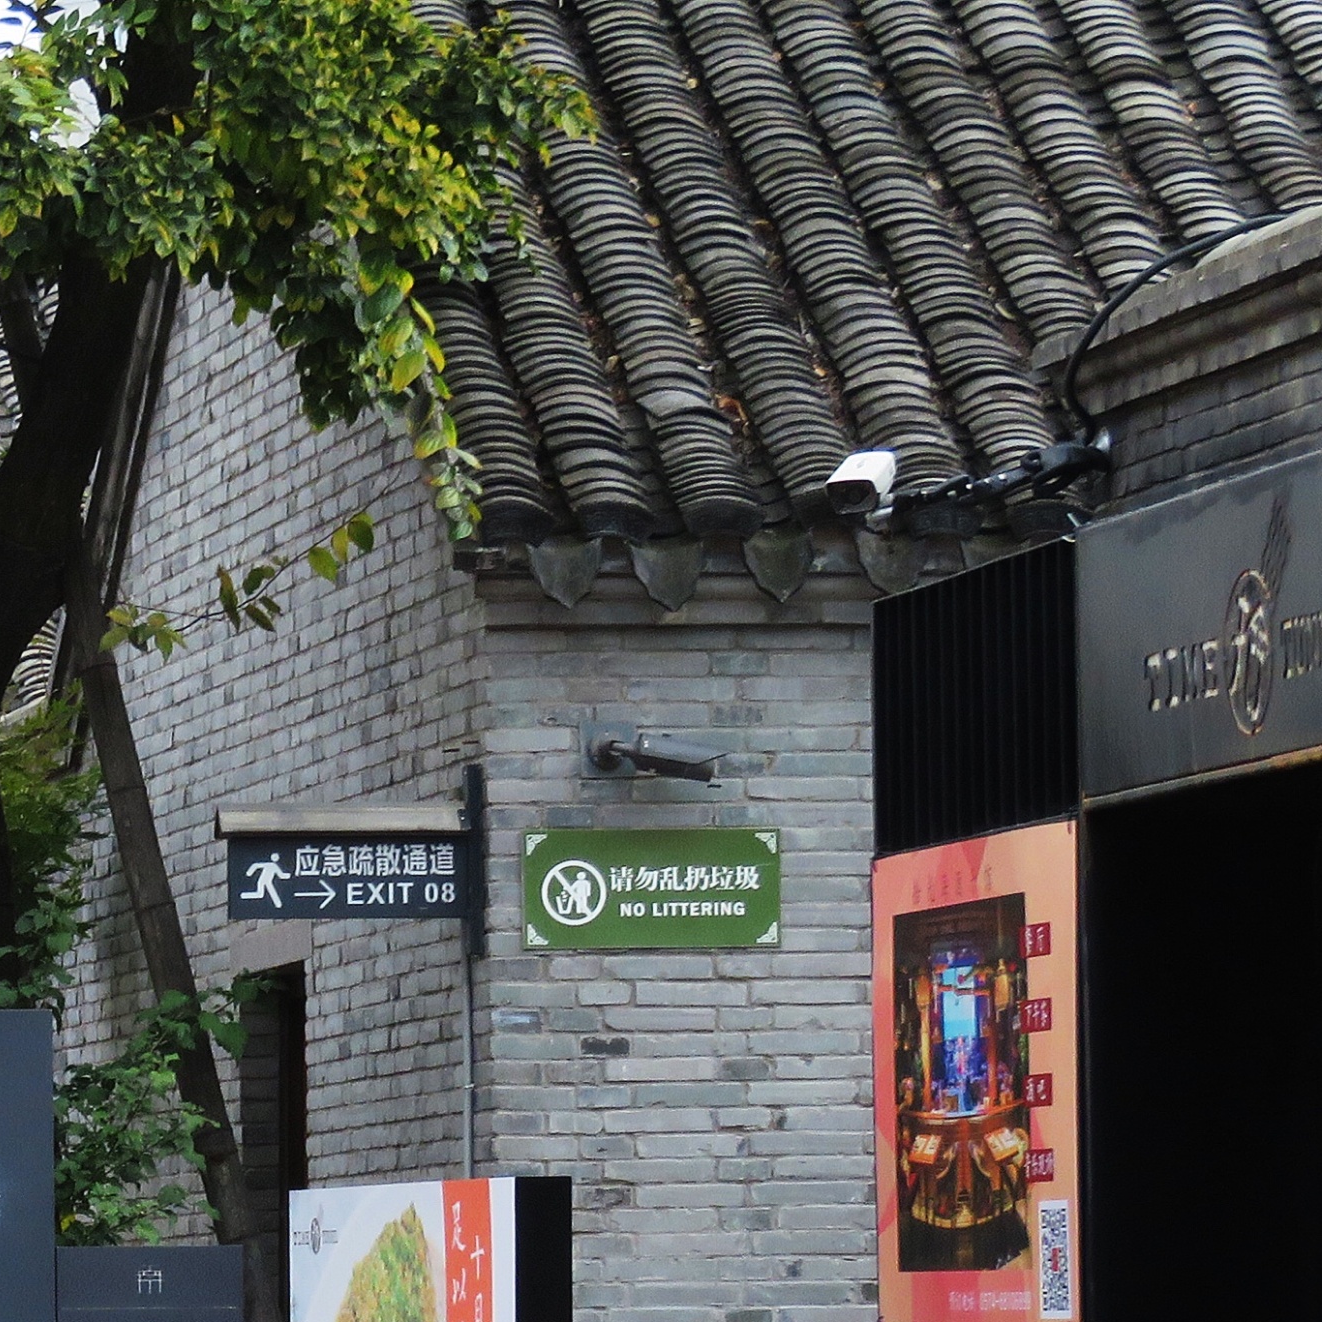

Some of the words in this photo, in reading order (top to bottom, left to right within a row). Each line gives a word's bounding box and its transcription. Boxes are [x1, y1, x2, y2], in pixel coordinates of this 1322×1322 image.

[293, 842, 456, 878] 应急疏散通道
[608, 865, 761, 892] 请勿乱扔垃圾
[346, 882, 415, 906] EXIT
[424, 881, 456, 904] 08
[619, 902, 646, 917] NO
[652, 901, 746, 918] LITTERING
